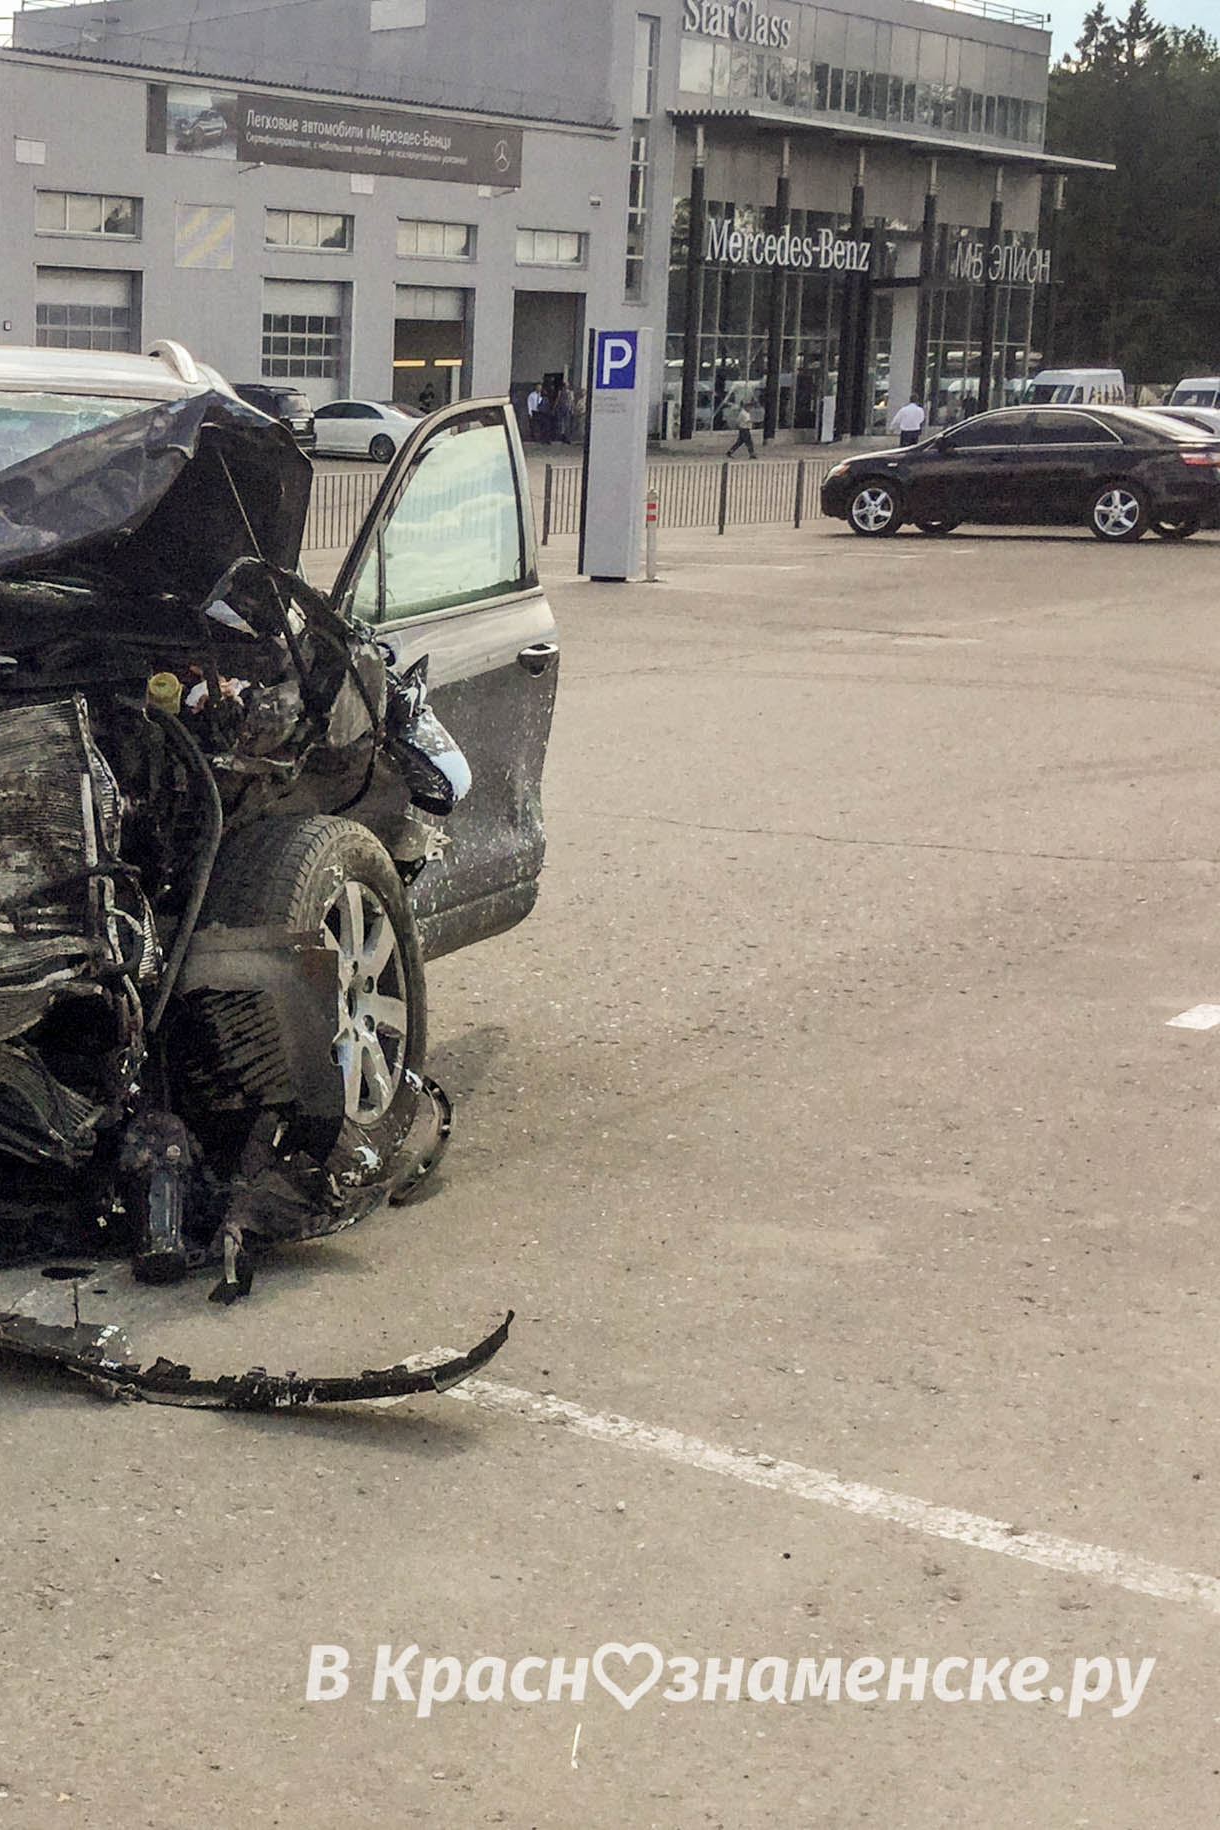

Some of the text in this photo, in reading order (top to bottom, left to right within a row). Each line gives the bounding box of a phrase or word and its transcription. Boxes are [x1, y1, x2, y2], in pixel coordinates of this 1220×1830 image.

[684, 0, 791, 48] StarClass
[245, 109, 299, 133] Легковые
[301, 119, 364, 139] автомобили
[705, 217, 872, 273] Mercedes-Benz
[602, 338, 633, 385] P
